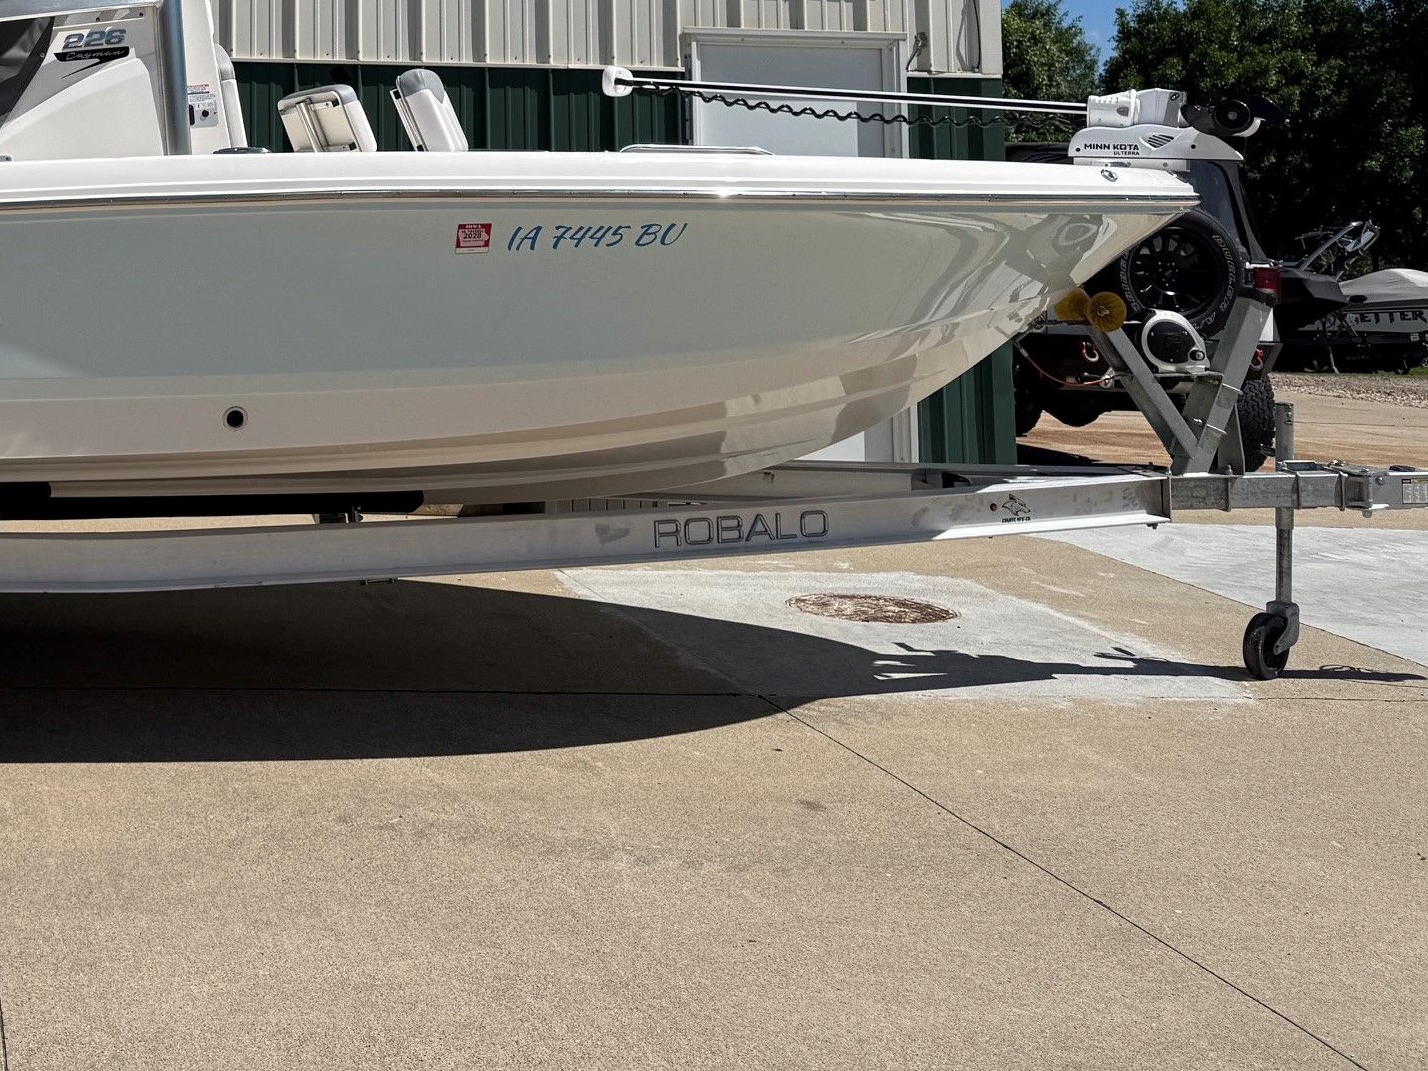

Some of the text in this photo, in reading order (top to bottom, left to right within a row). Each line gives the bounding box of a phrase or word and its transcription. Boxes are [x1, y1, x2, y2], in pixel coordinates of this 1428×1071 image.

[61, 28, 127, 49] 226
[1112, 143, 1140, 151] KOTA
[507, 223, 688, 252] IA 7445 BU
[653, 509, 830, 549] ROBALO
